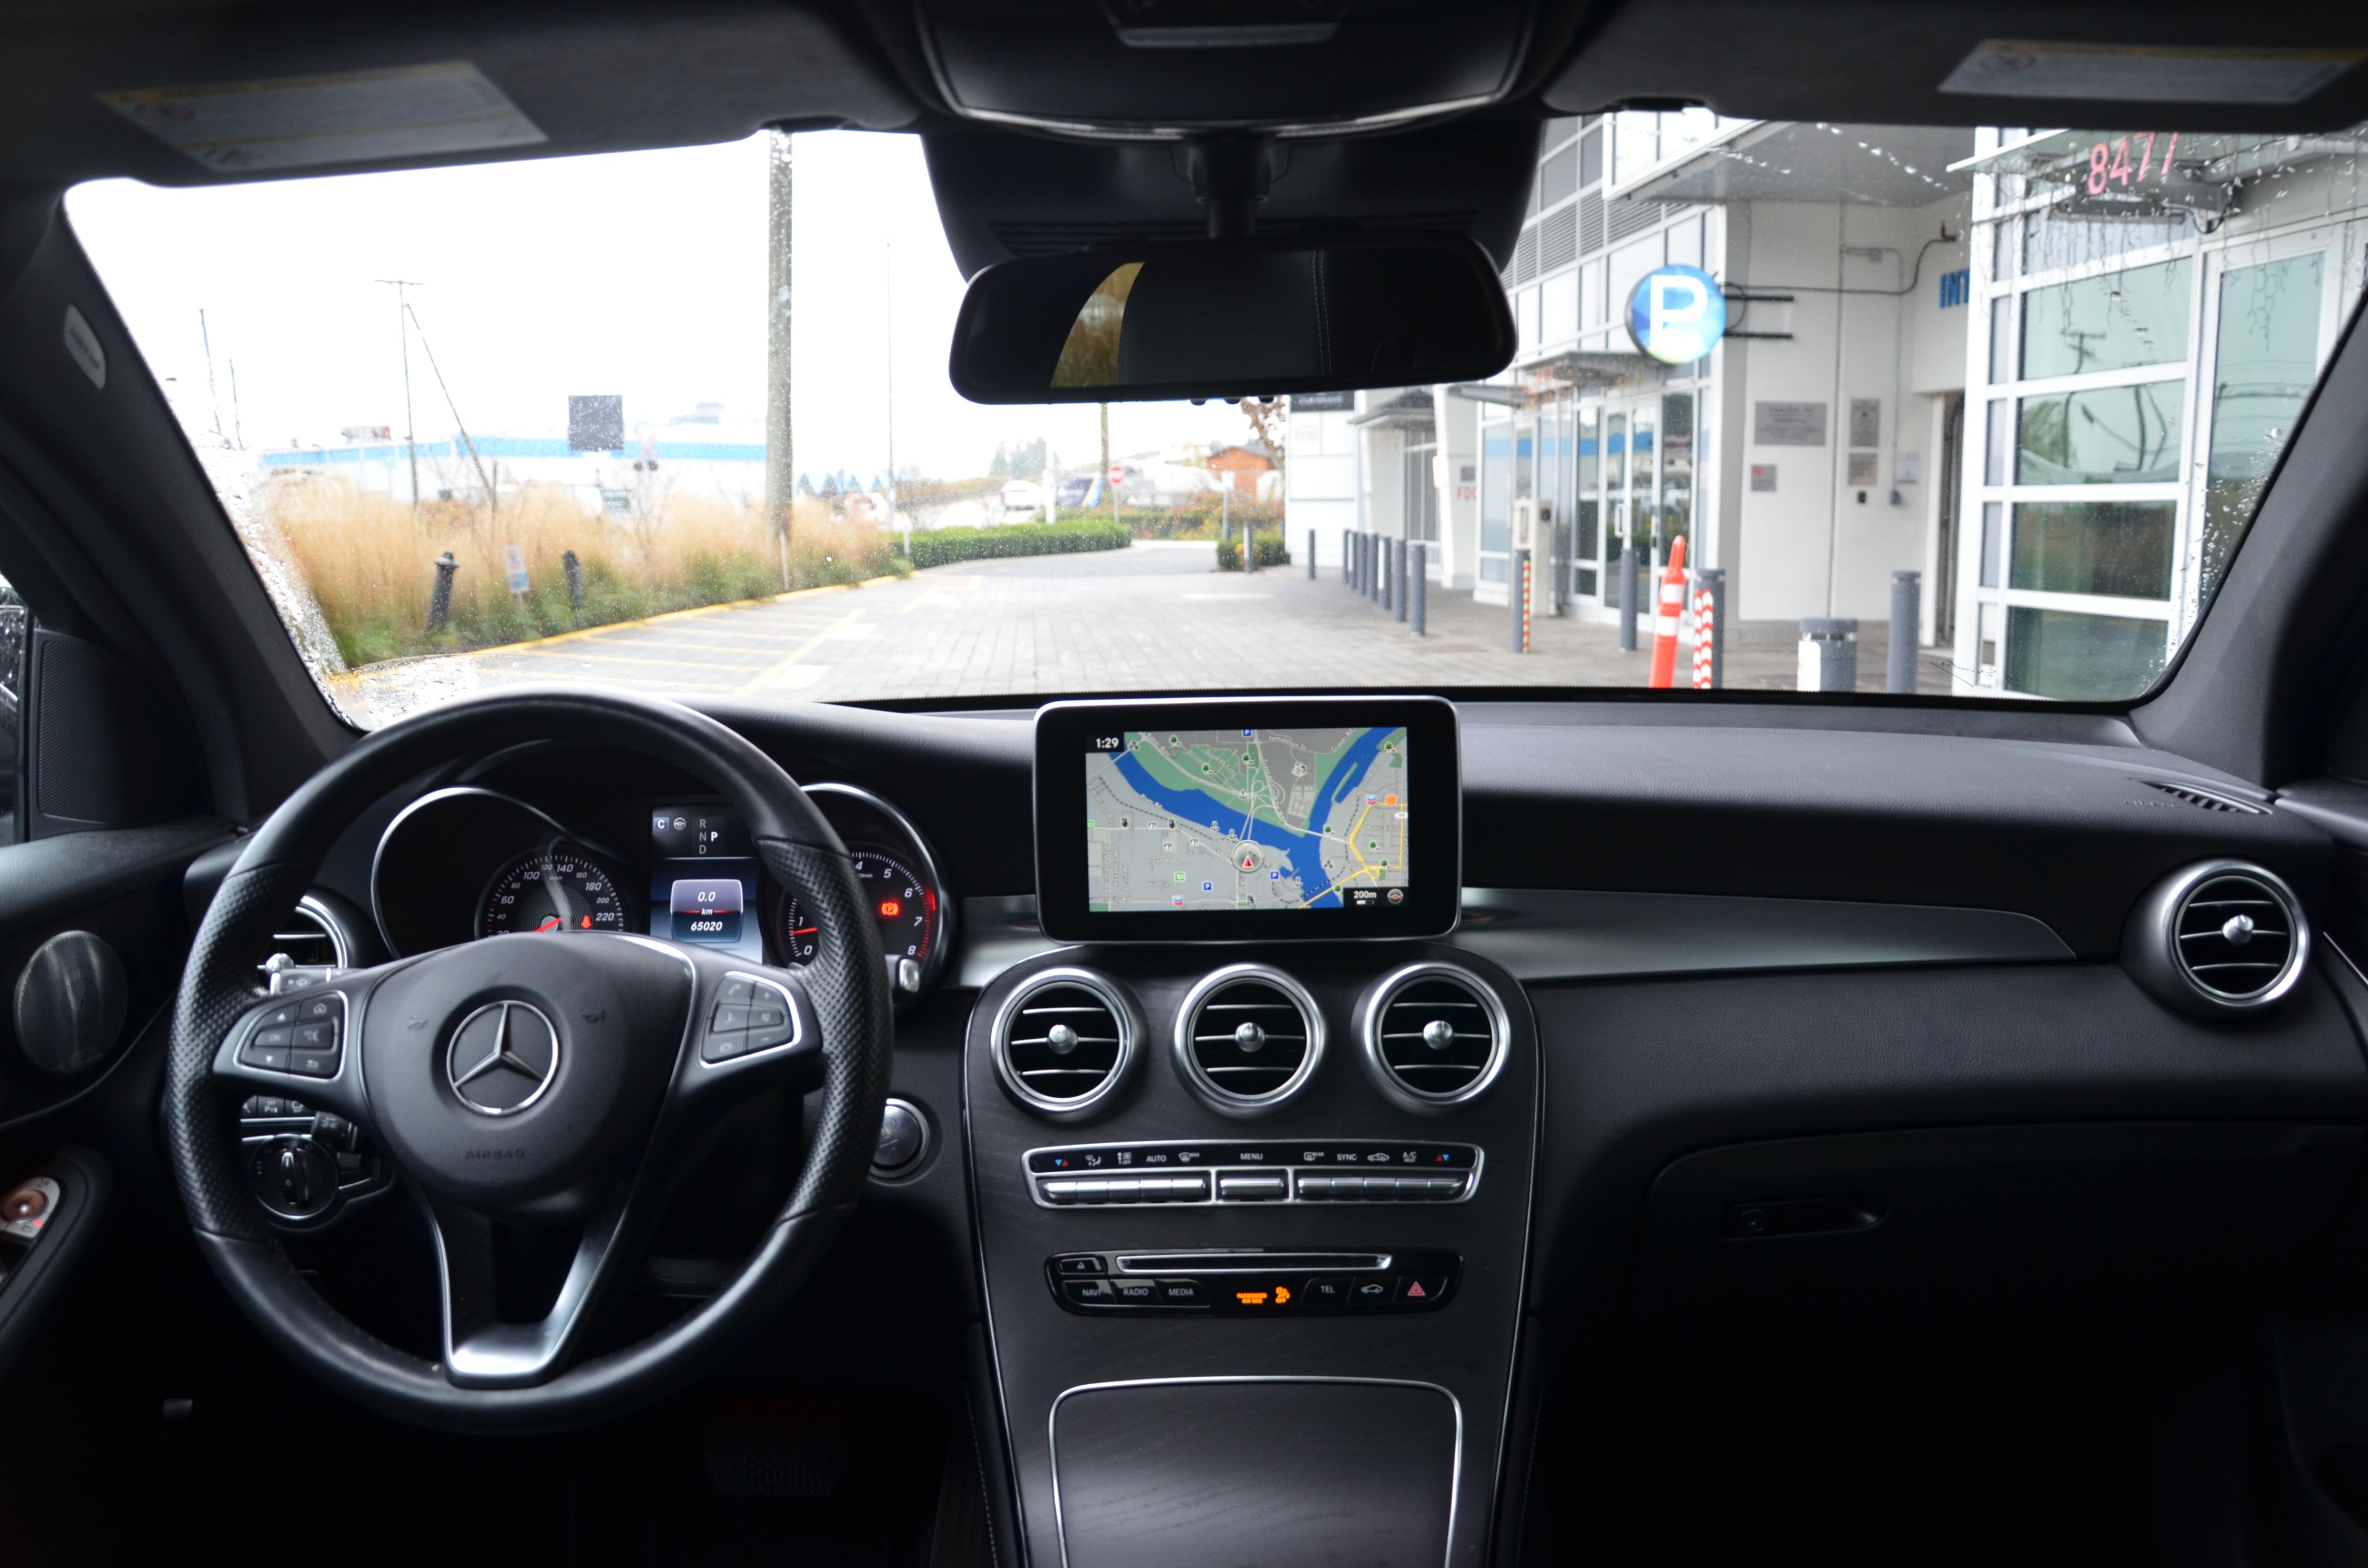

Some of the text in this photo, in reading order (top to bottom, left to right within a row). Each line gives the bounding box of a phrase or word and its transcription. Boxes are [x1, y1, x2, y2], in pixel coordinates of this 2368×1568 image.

[1650, 275, 1708, 352] P
[1096, 738, 1119, 748] 1:29
[657, 820, 665, 829] C
[700, 819, 707, 828] R
[700, 832, 707, 841] N
[710, 831, 718, 841] P
[699, 844, 707, 854] D
[557, 864, 574, 872] 140
[855, 861, 864, 870] 4
[883, 869, 892, 878] 5
[585, 882, 602, 891] 180
[698, 891, 716, 902] 0.0
[904, 888, 913, 898] 6
[596, 913, 614, 921] 220
[798, 917, 804, 926] 1
[914, 917, 923, 926] 7
[690, 921, 723, 931] 65020
[804, 945, 813, 955] 0
[907, 945, 916, 955] 8
[1123, 1288, 1148, 1296] RADIO
